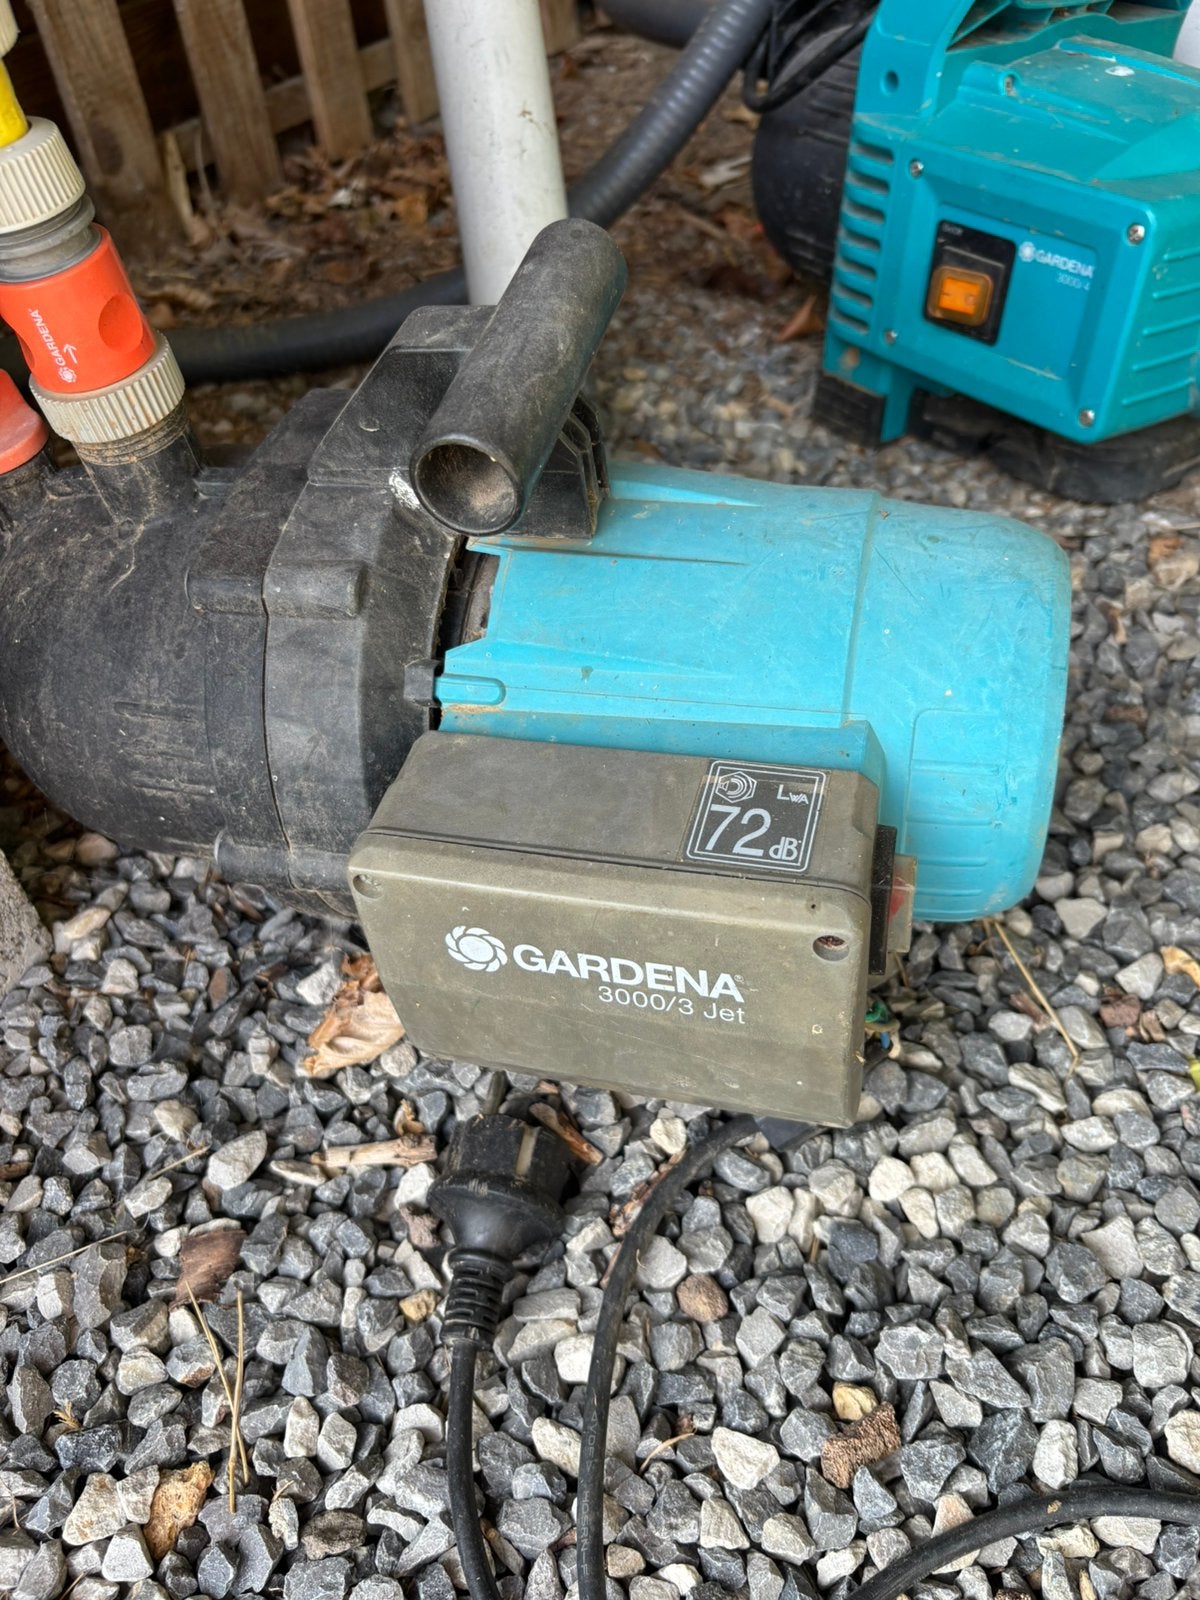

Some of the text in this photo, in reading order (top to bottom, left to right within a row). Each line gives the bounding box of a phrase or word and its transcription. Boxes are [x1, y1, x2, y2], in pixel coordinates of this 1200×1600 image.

[1036, 249, 1094, 279] GARDENA
[30, 309, 66, 367] GARDENA
[705, 803, 798, 861] 72 dB
[512, 943, 744, 1003] GARDENA
[597, 985, 746, 1024] 3000/3 Jet
